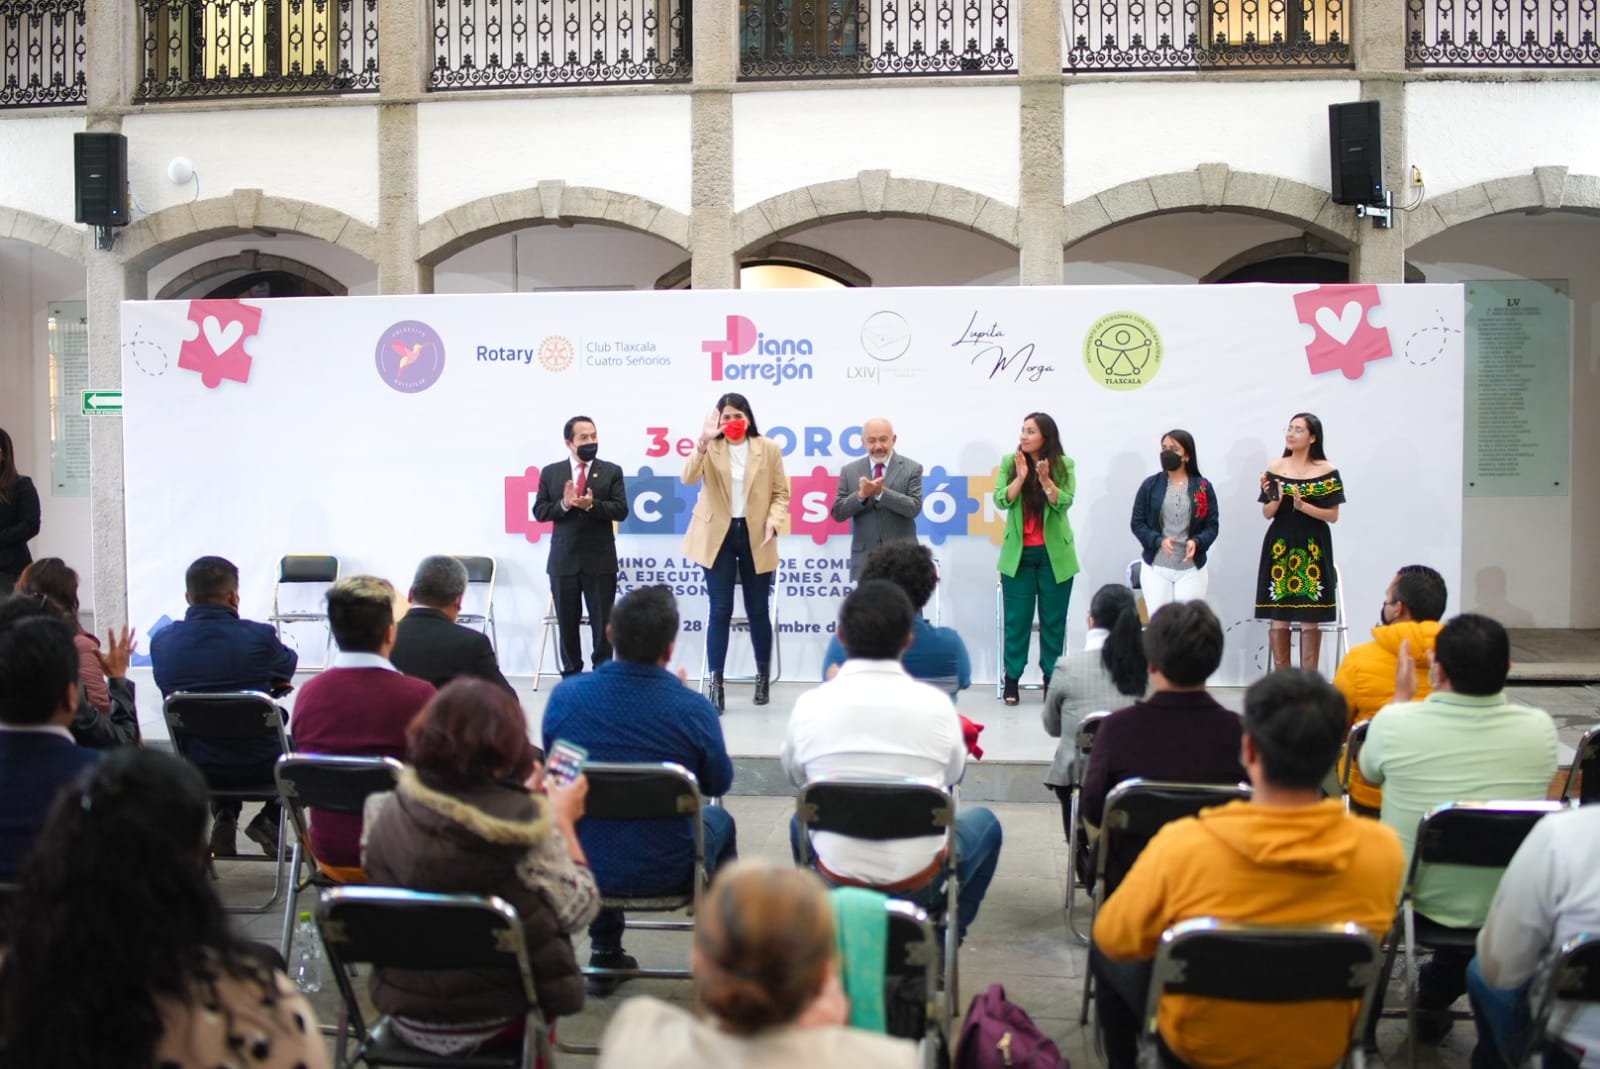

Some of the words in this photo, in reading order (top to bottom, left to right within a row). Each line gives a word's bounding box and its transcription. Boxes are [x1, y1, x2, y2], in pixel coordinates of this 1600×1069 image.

[1507, 298, 1520, 307] LV
[952, 310, 1005, 346] Lupita
[727, 315, 813, 356] Diana
[586, 342, 611, 352] Club
[616, 341, 656, 352] Tlaxcala
[476, 345, 534, 364] Rotary
[586, 356, 623, 367] Cuatro
[701, 340, 813, 386] Torrejón
[847, 367, 876, 379] LXIV
[763, 425, 864, 457] ORO
[664, 557, 676, 569] A
[779, 572, 823, 583] ONES
[830, 572, 842, 583] A
[786, 586, 853, 597] DISCAP
[683, 620, 702, 632] 28
